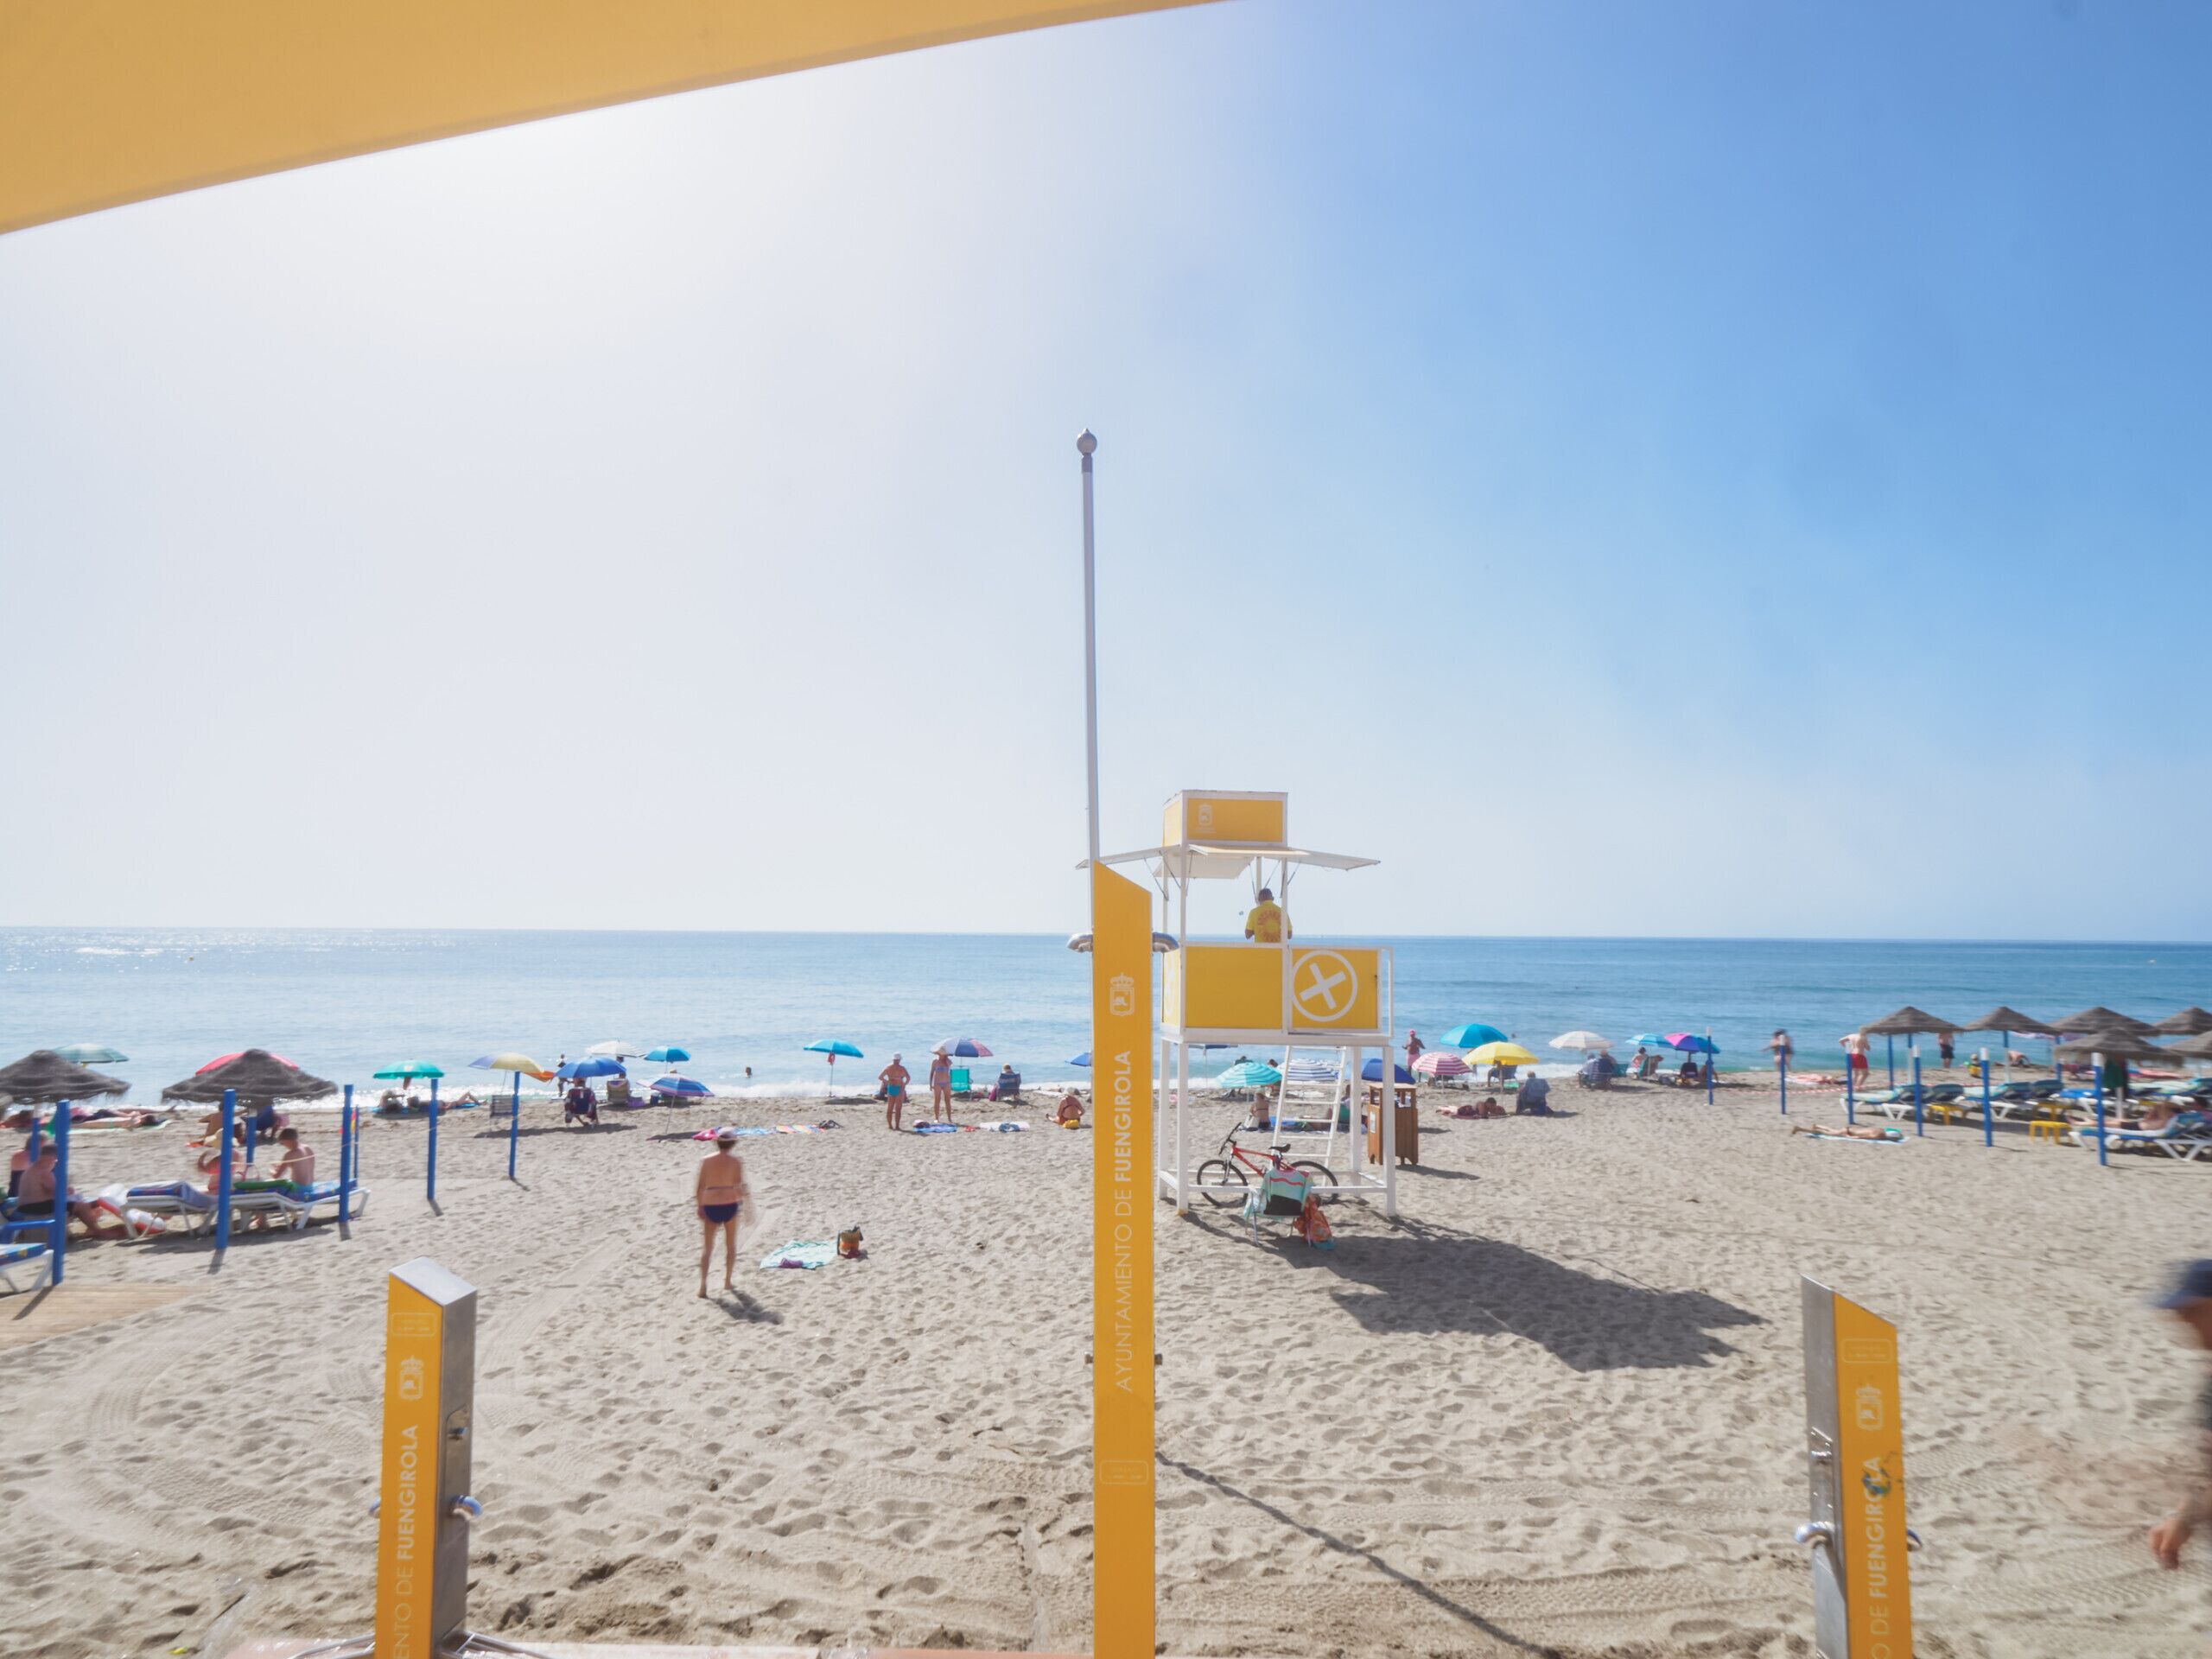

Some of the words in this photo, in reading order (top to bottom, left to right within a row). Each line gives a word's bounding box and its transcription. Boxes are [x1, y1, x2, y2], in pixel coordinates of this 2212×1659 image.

[1113, 1051, 1132, 1182] FUENGIROLA
[1114, 1189, 1132, 1216] DE
[1114, 1223, 1132, 1392] AYUNTAMIENTO
[396, 1424, 418, 1560] FUENGIROLA
[395, 1567, 414, 1596] DE
[1869, 1605, 1891, 1636] DE
